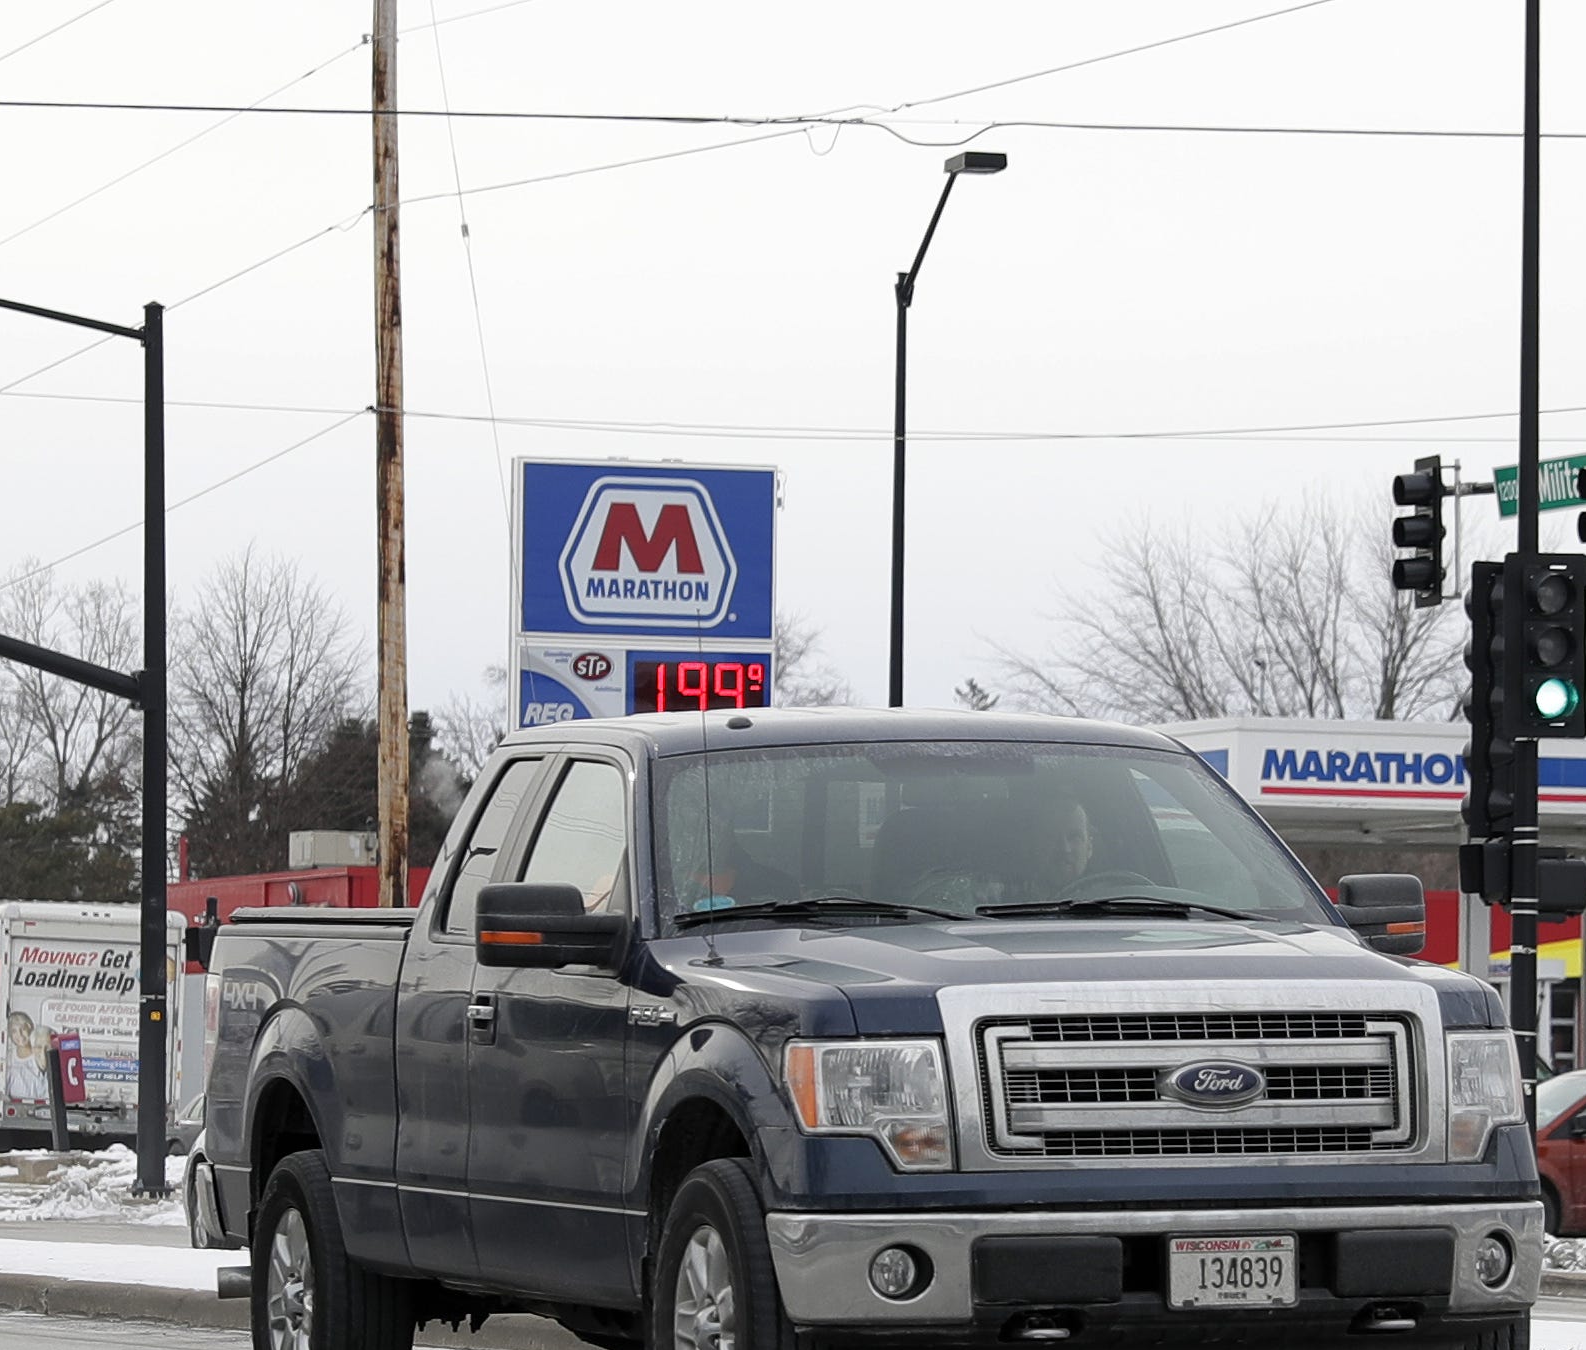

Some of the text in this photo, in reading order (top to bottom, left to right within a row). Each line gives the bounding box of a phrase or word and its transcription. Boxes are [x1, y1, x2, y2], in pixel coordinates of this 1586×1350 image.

[591, 503, 705, 575] M
[586, 577, 709, 602] MARATHON
[577, 656, 607, 677] STP
[100, 949, 133, 968] Get
[13, 967, 135, 996] Loading Help
[1194, 1069, 1244, 1091] Ford
[1175, 1240, 1240, 1251] WISCONSIN
[1198, 1257, 1283, 1290] 134839
